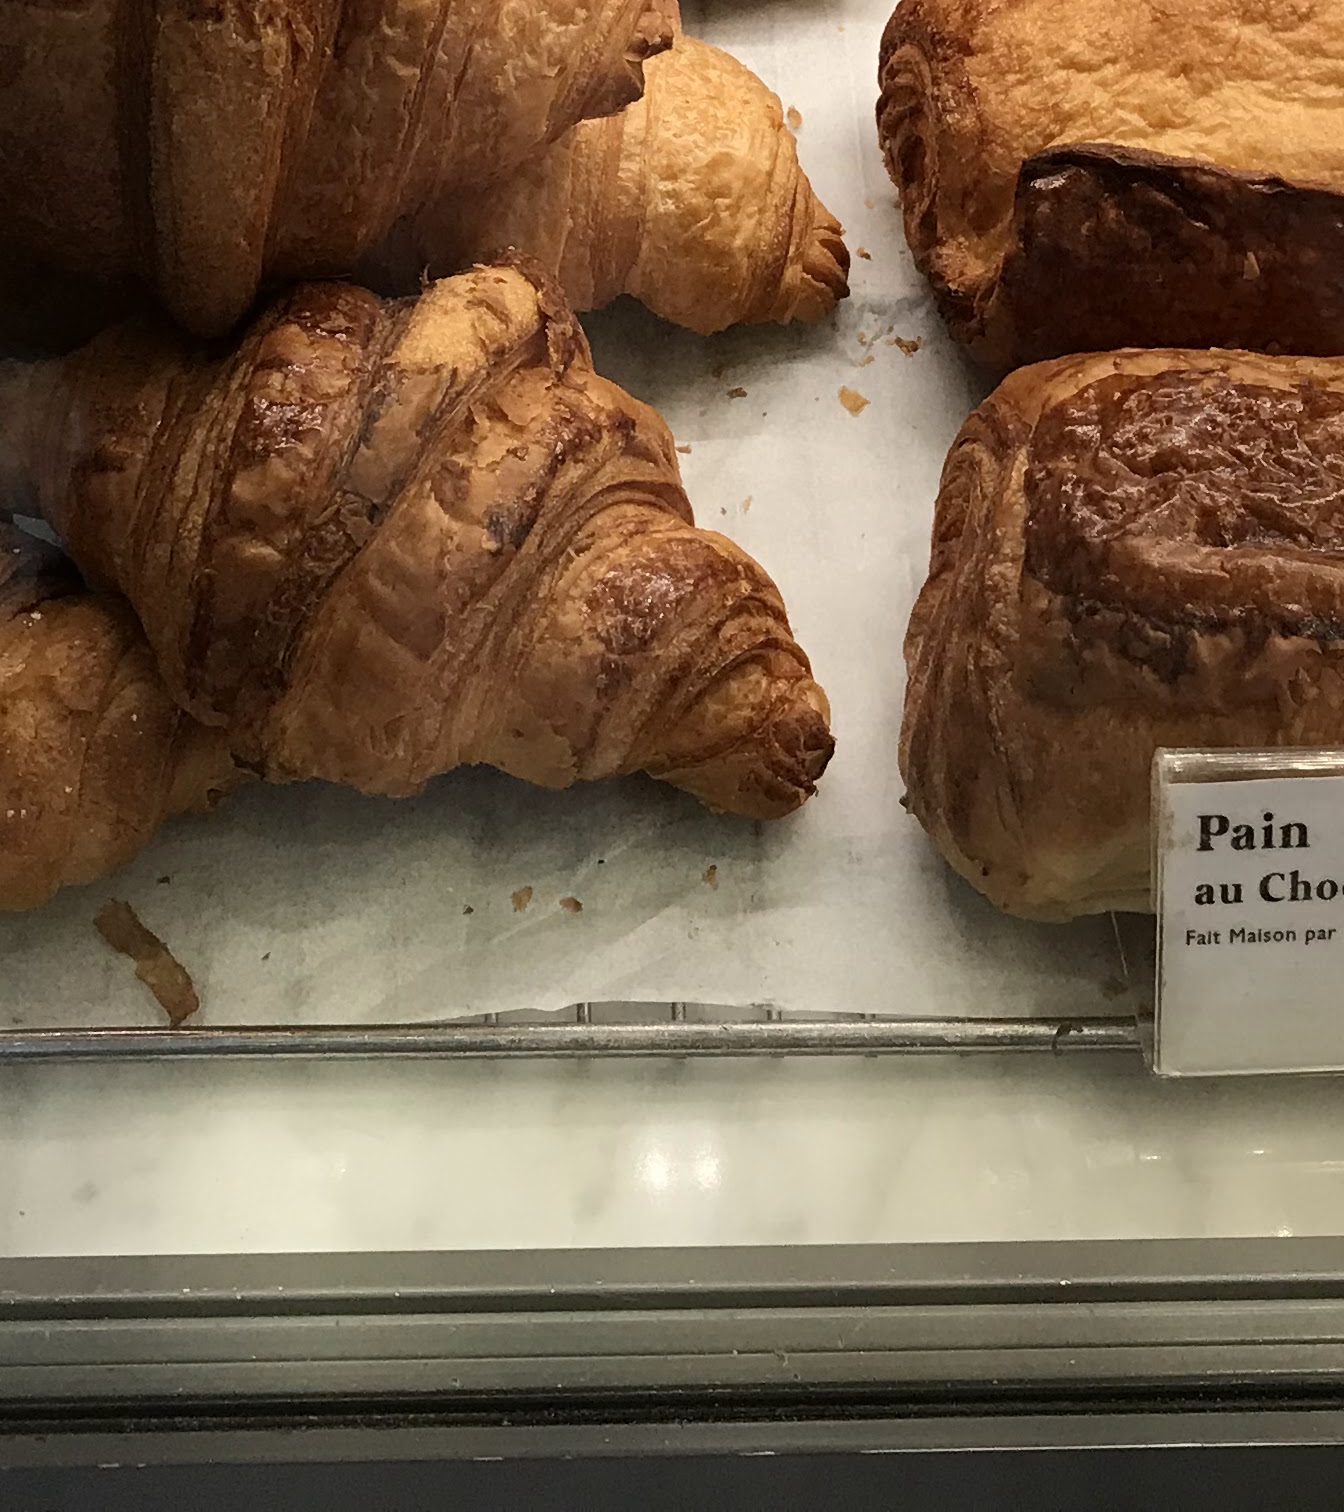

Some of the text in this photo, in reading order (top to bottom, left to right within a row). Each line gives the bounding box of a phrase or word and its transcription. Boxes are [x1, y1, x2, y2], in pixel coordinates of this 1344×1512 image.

[1196, 812, 1310, 852] Pain
[1195, 879, 1243, 905] au
[1186, 928, 1221, 946] Fait
[1230, 927, 1296, 943] Maison
[1305, 927, 1336, 947] par
